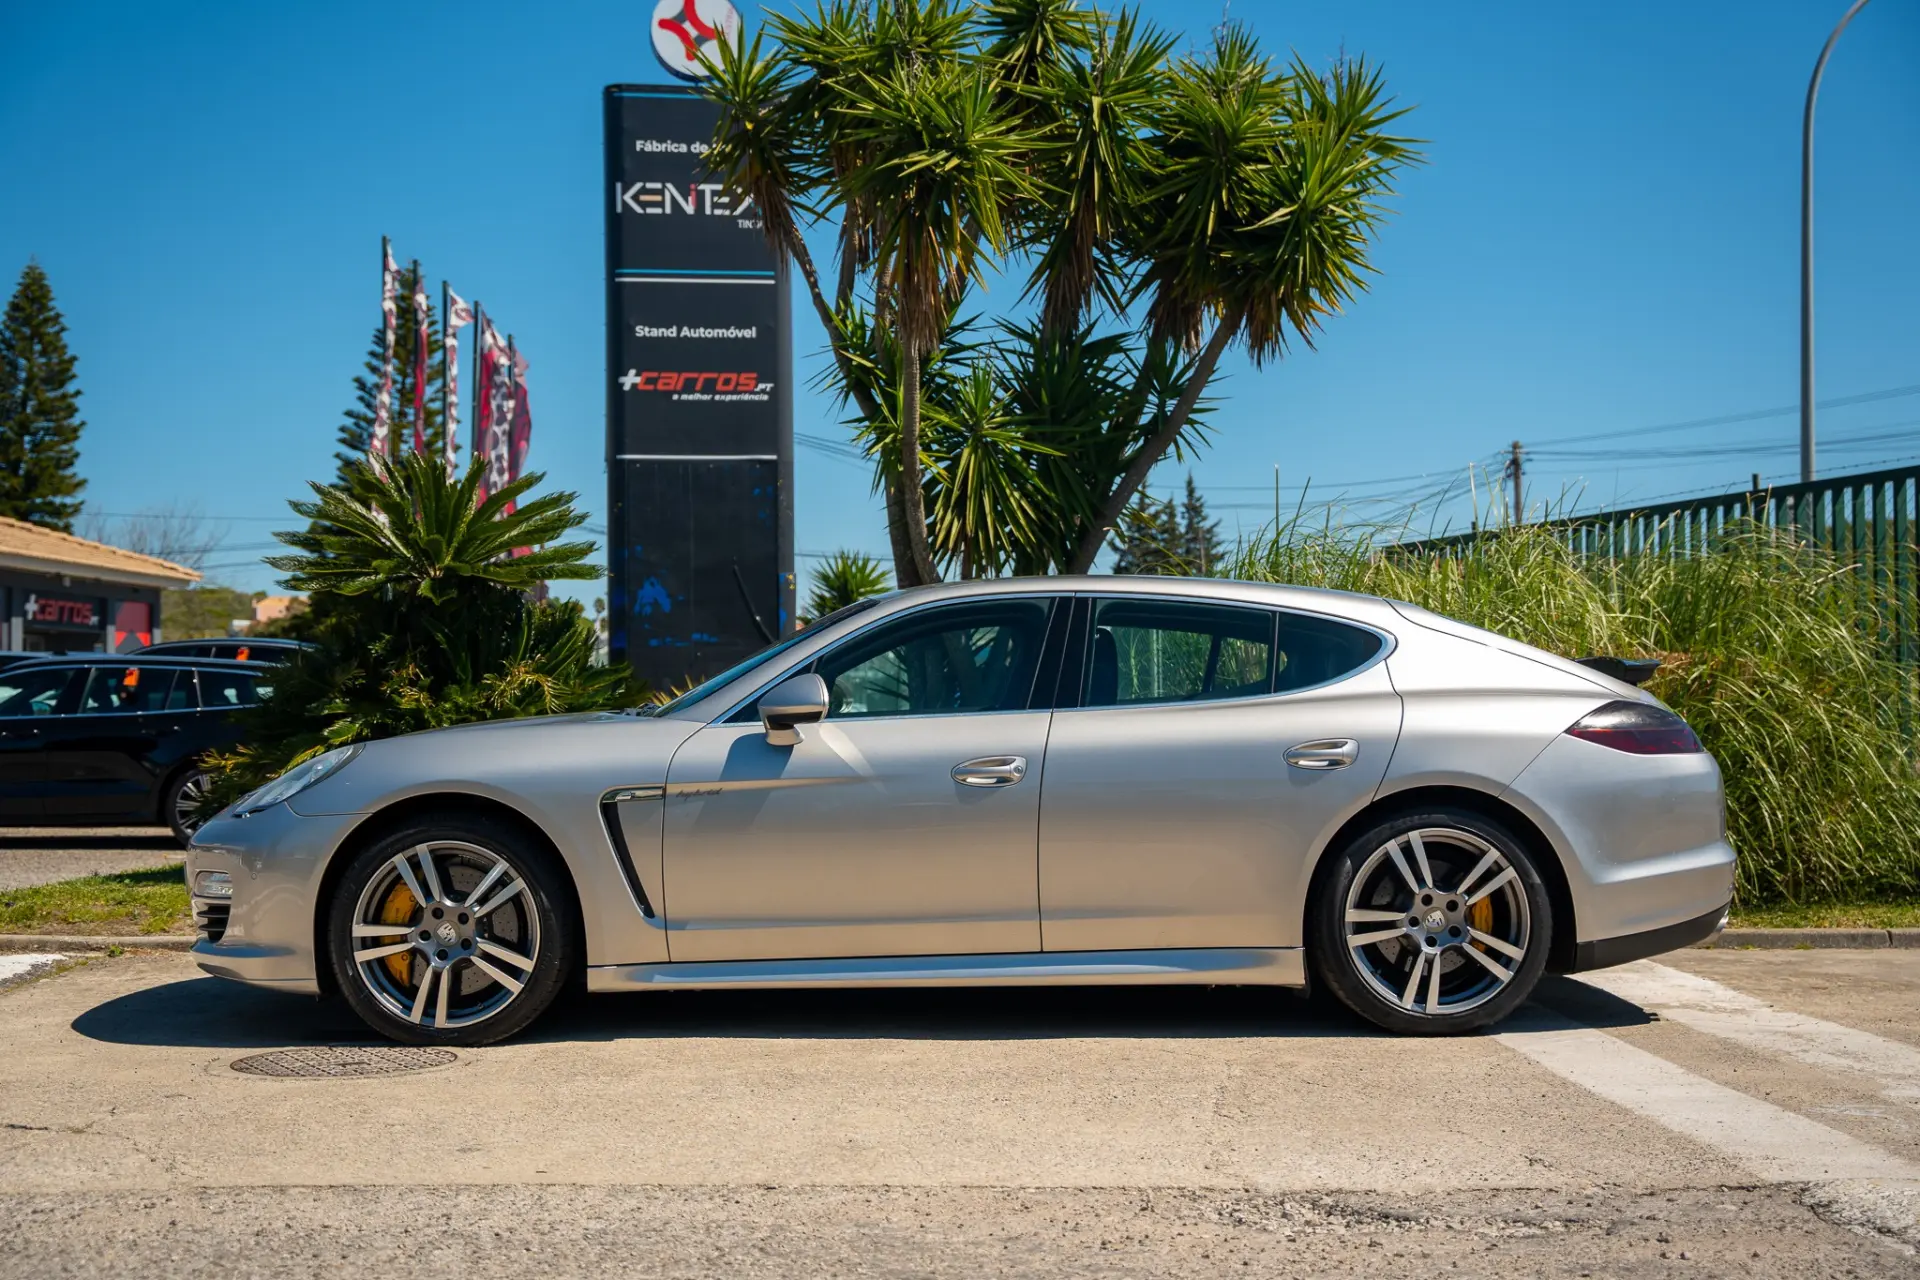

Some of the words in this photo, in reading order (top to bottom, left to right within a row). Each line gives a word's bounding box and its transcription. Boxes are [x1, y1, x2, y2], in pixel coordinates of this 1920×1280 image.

[635, 139, 688, 153] Fábrica
[690, 141, 709, 153] de
[635, 325, 677, 338] Stand
[680, 325, 757, 339] Automóvel
